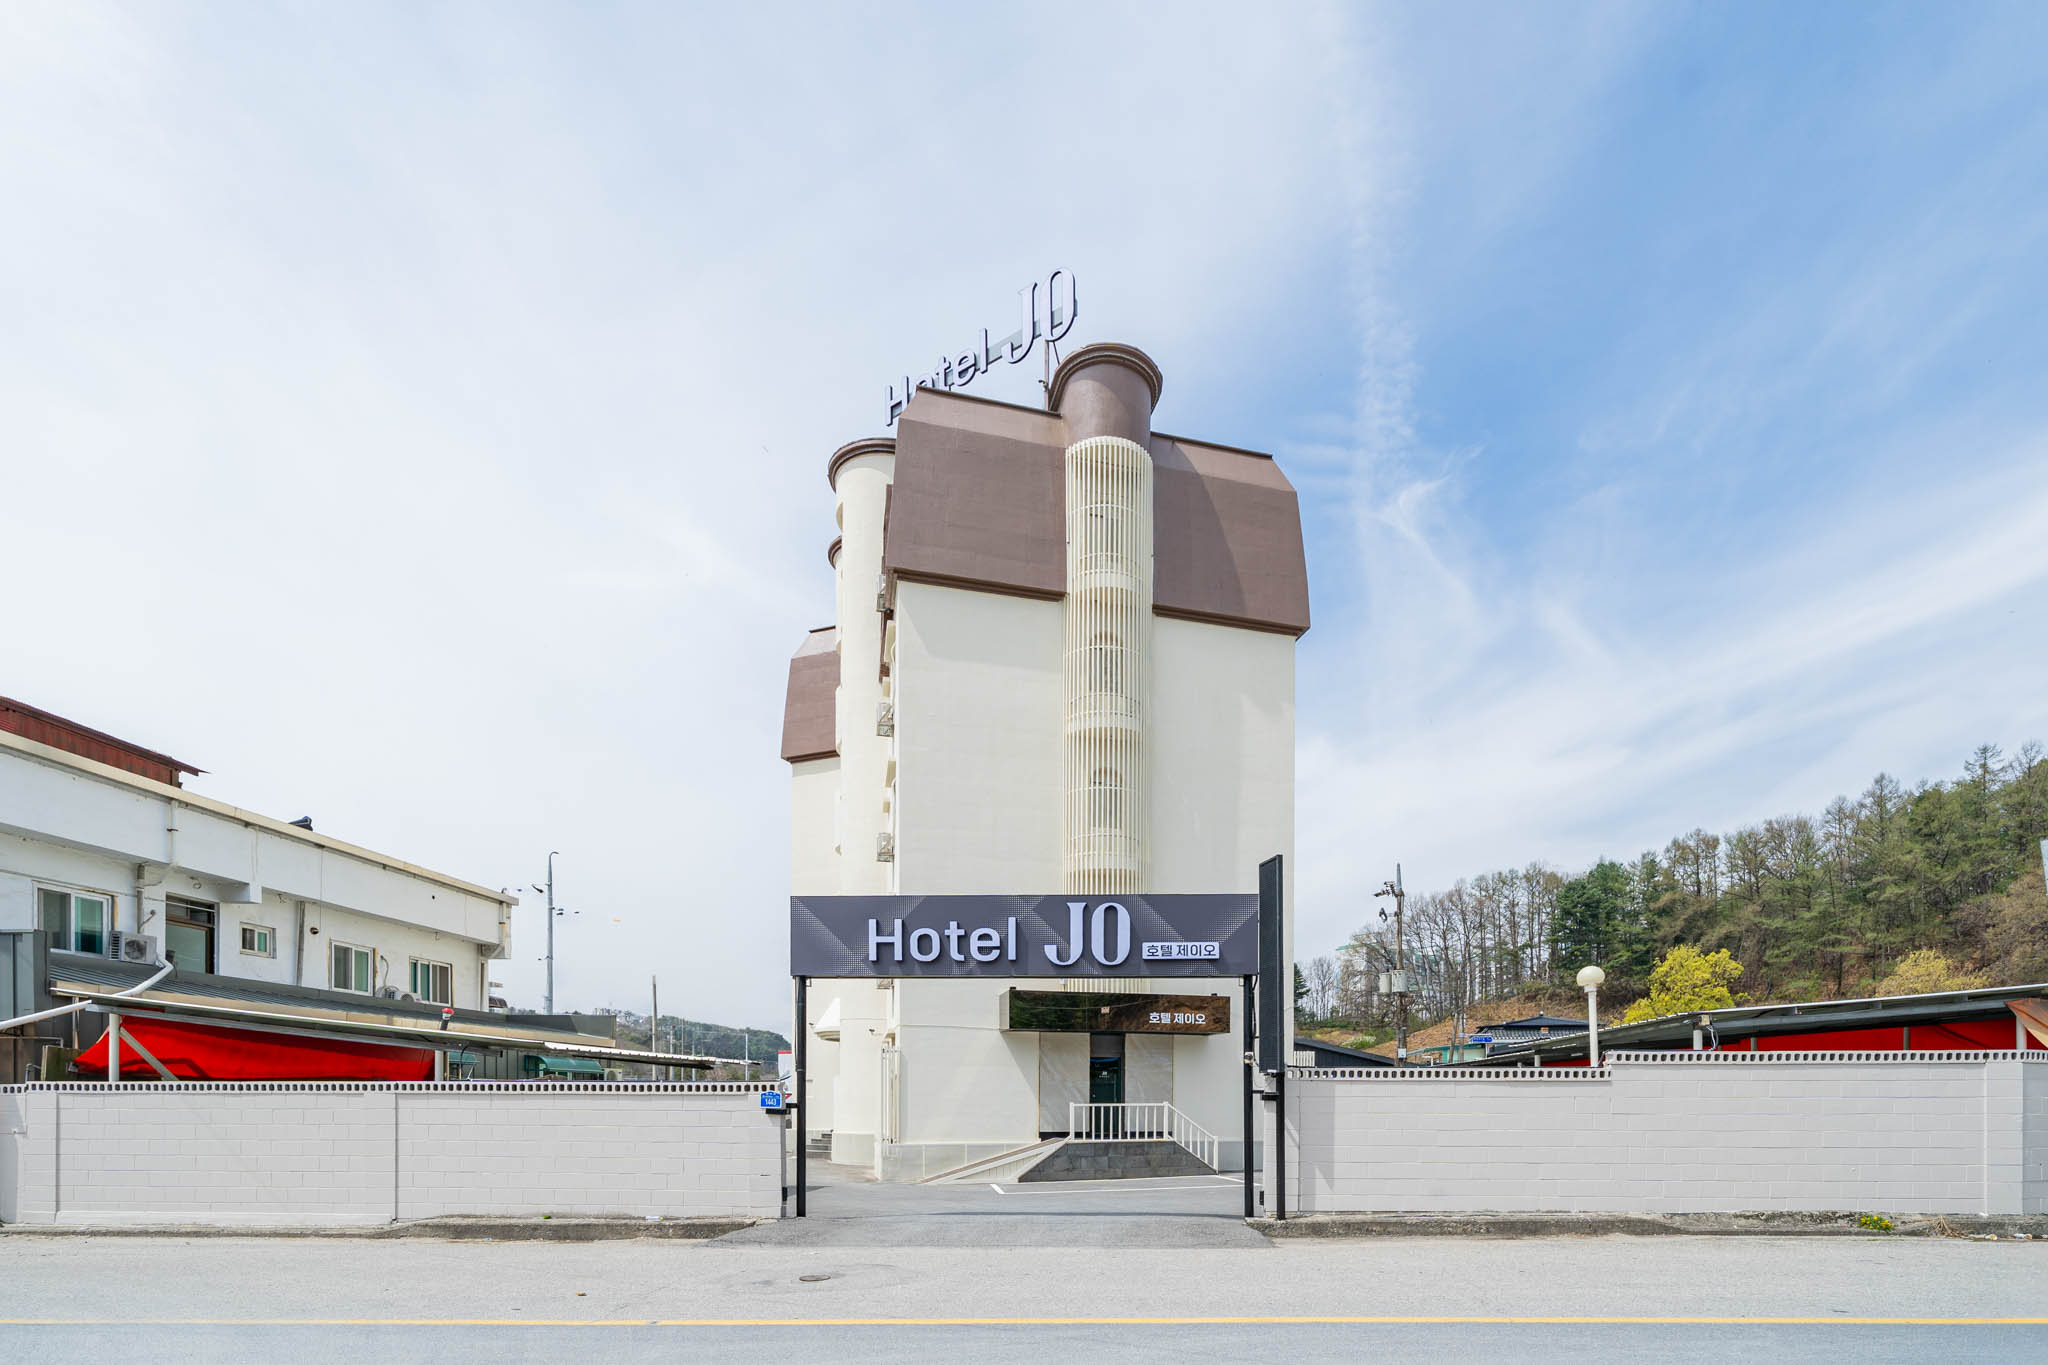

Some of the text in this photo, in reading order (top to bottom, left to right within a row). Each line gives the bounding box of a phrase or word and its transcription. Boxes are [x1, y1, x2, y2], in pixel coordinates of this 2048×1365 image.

[1001, 266, 1076, 364] JO
[868, 902, 1131, 966] Hotel JO
[1146, 944, 1217, 957] 호텔 제이오
[1149, 1012, 1206, 1025] 호텔 제이오
